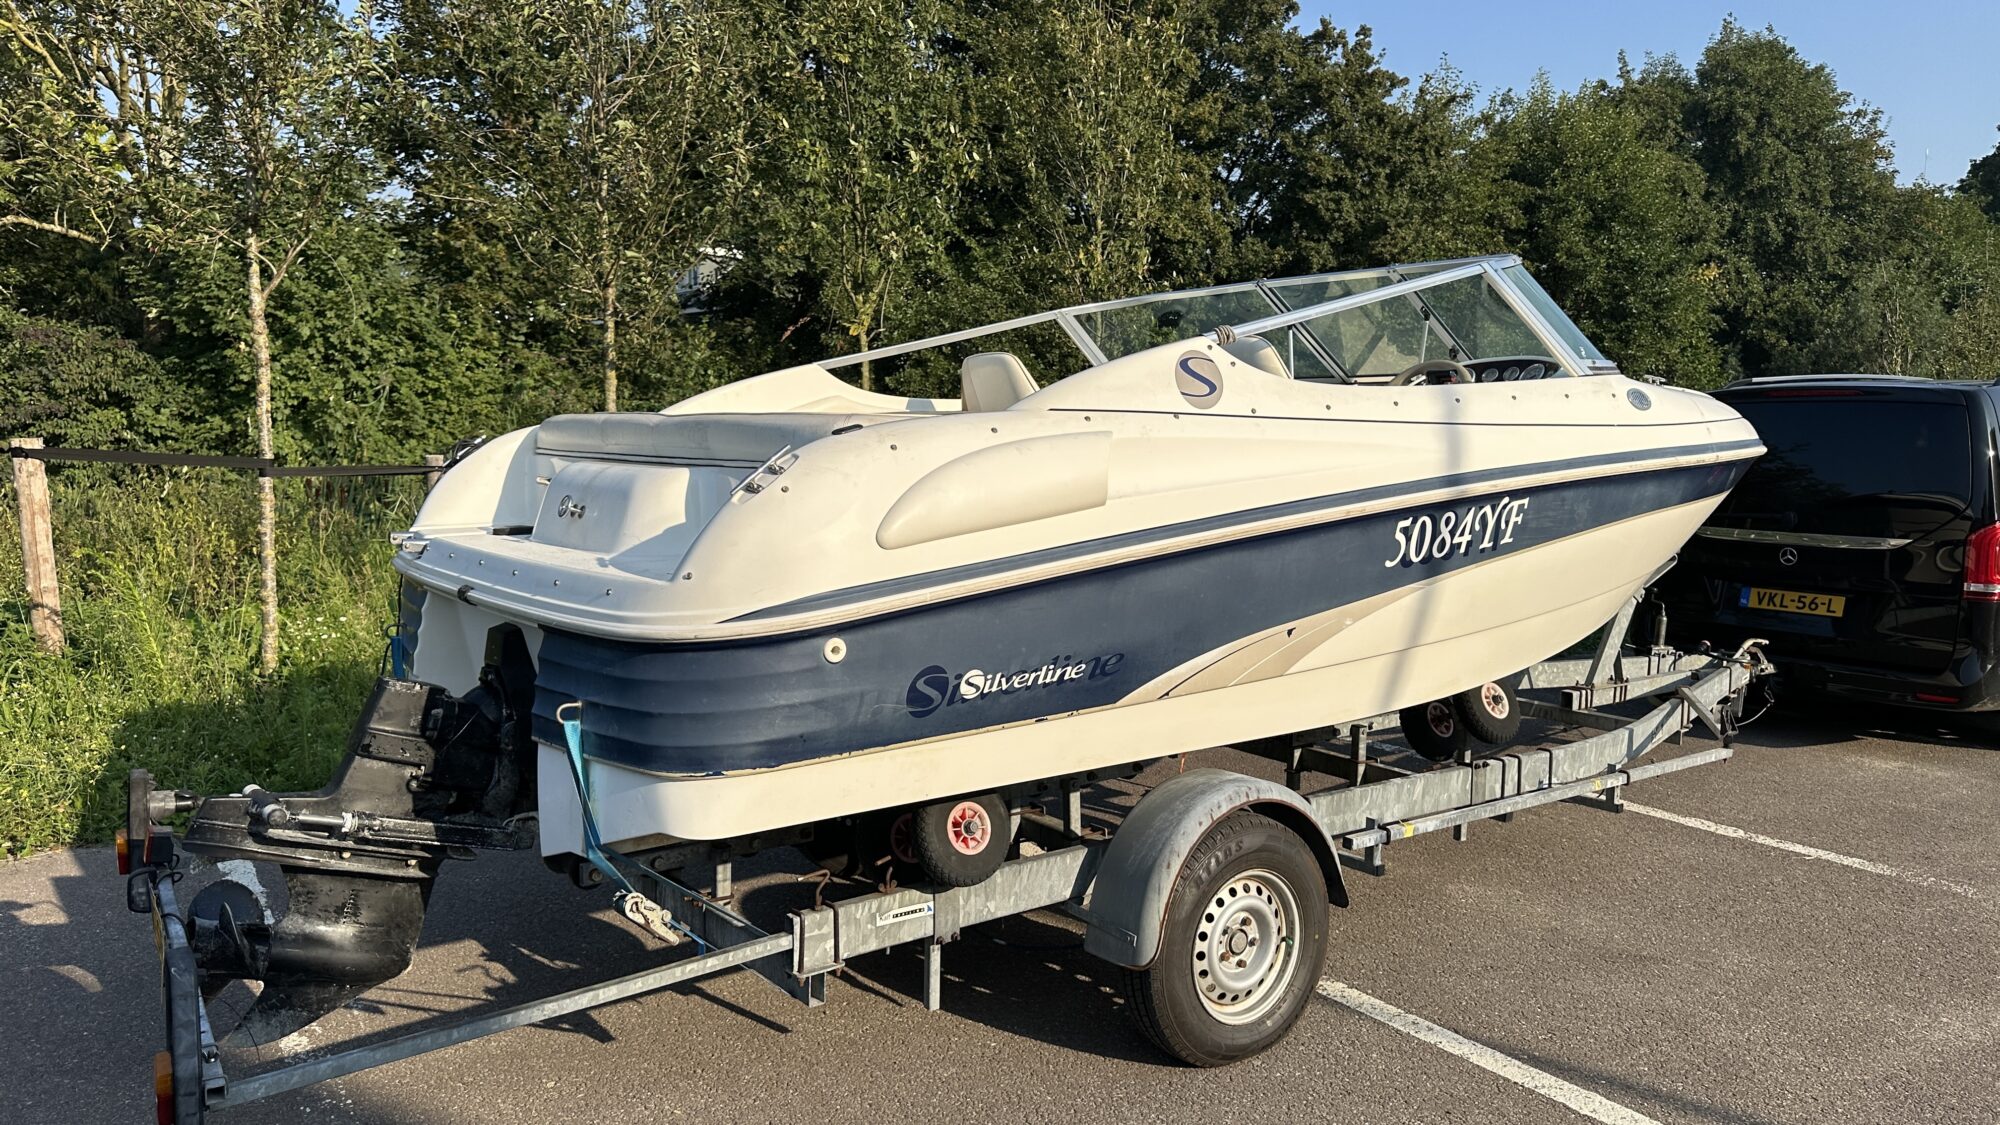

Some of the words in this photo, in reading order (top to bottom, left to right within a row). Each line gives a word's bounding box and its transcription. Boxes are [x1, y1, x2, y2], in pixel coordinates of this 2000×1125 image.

[1384, 496, 1530, 568] 5084YF
[1756, 590, 1837, 614] VKL-56-L
[959, 663, 1087, 700] Silverline
